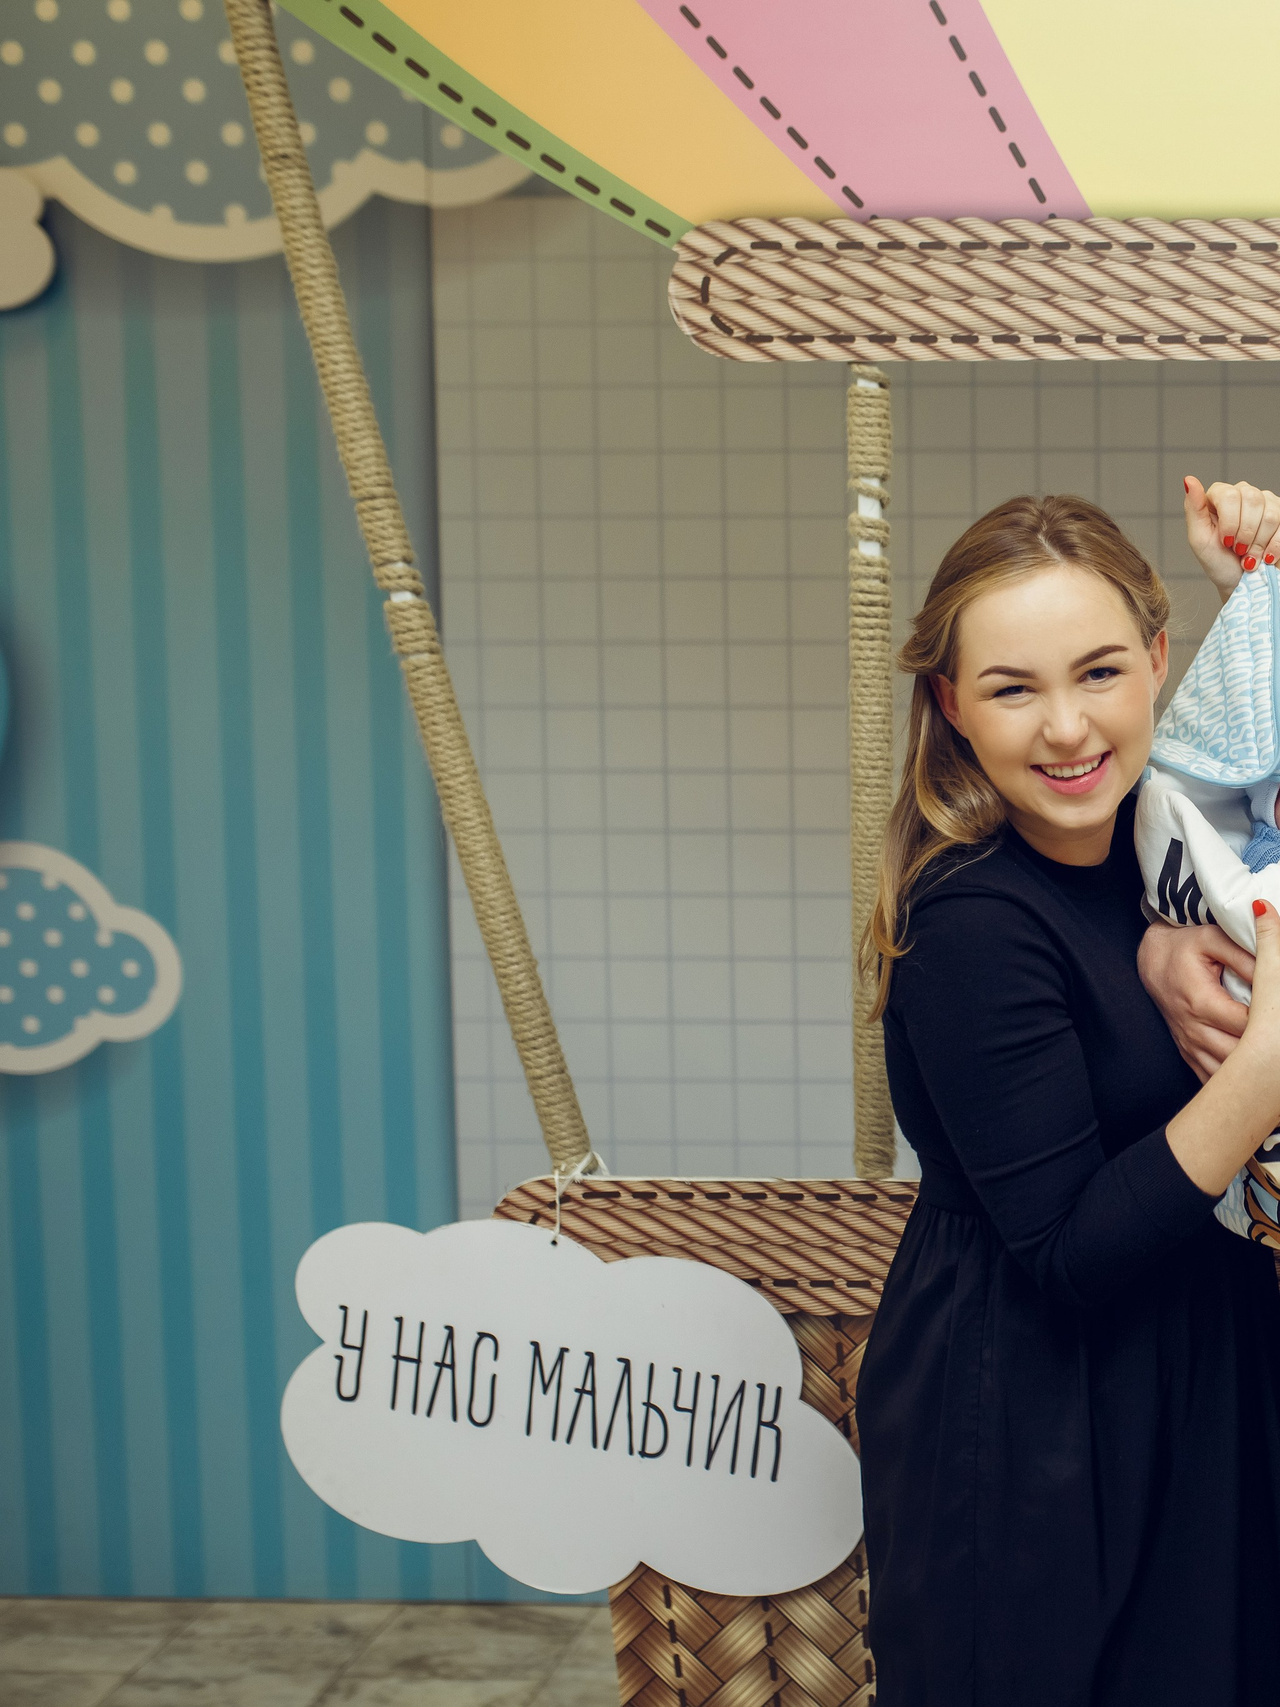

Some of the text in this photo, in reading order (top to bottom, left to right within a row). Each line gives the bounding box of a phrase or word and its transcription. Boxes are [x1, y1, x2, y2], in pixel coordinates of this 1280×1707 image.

[334, 1304, 782, 1483] У НАС МАЛЬЧИК
